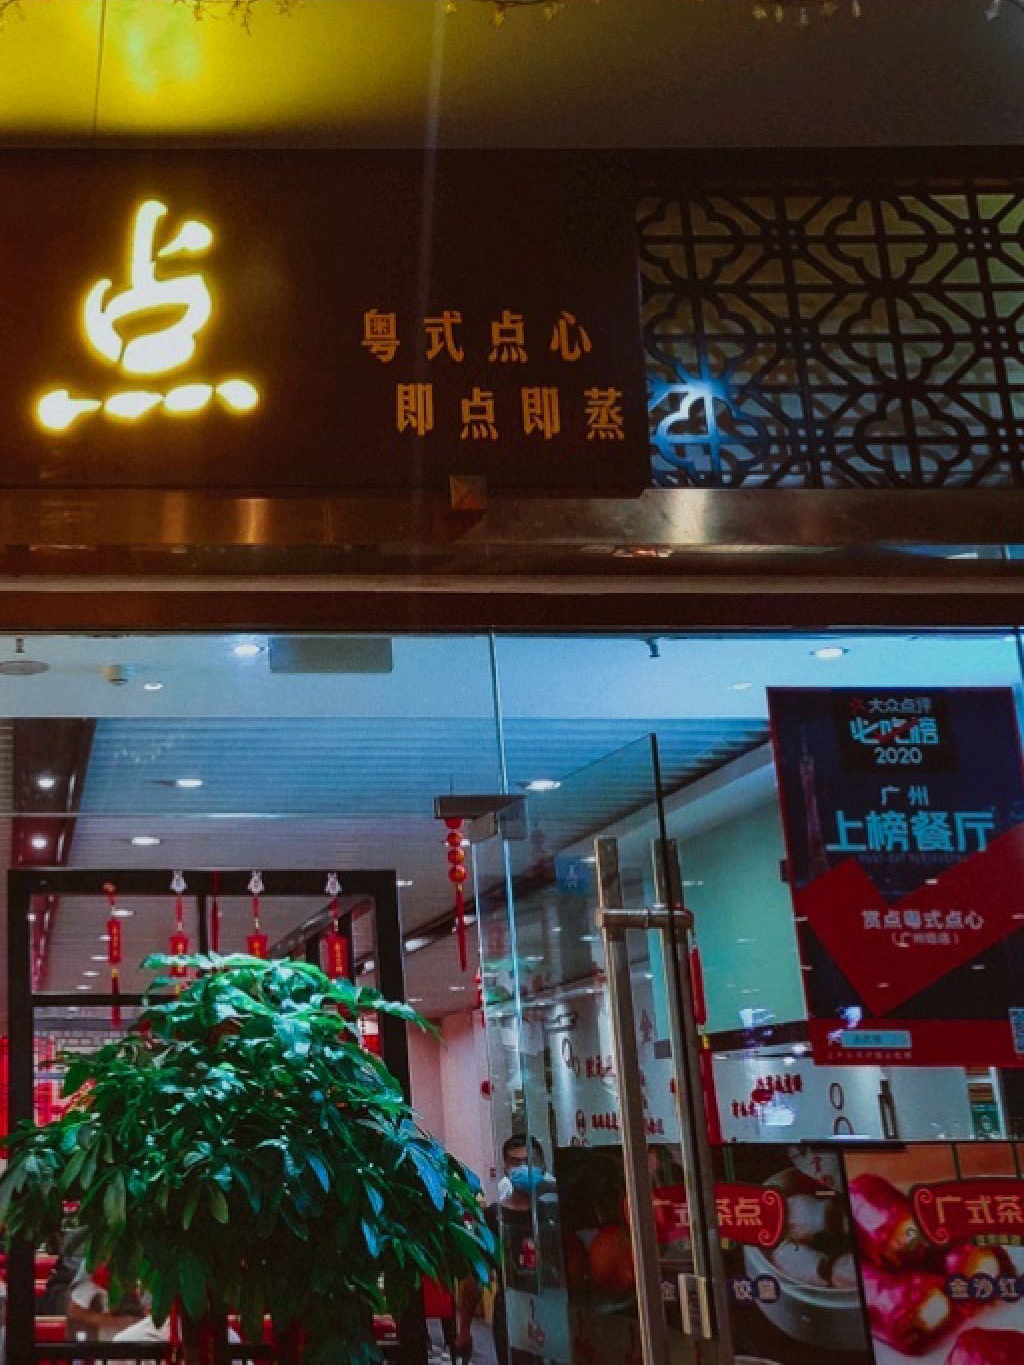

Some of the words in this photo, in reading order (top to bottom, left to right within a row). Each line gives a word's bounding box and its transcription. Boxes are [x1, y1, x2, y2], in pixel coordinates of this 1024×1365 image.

[361, 308, 593, 364] 粤式点心
[395, 382, 626, 441] 即点即蒸
[874, 746, 922, 764] 2020
[881, 785, 929, 806] 广州
[826, 810, 994, 852] 上榜餐厅
